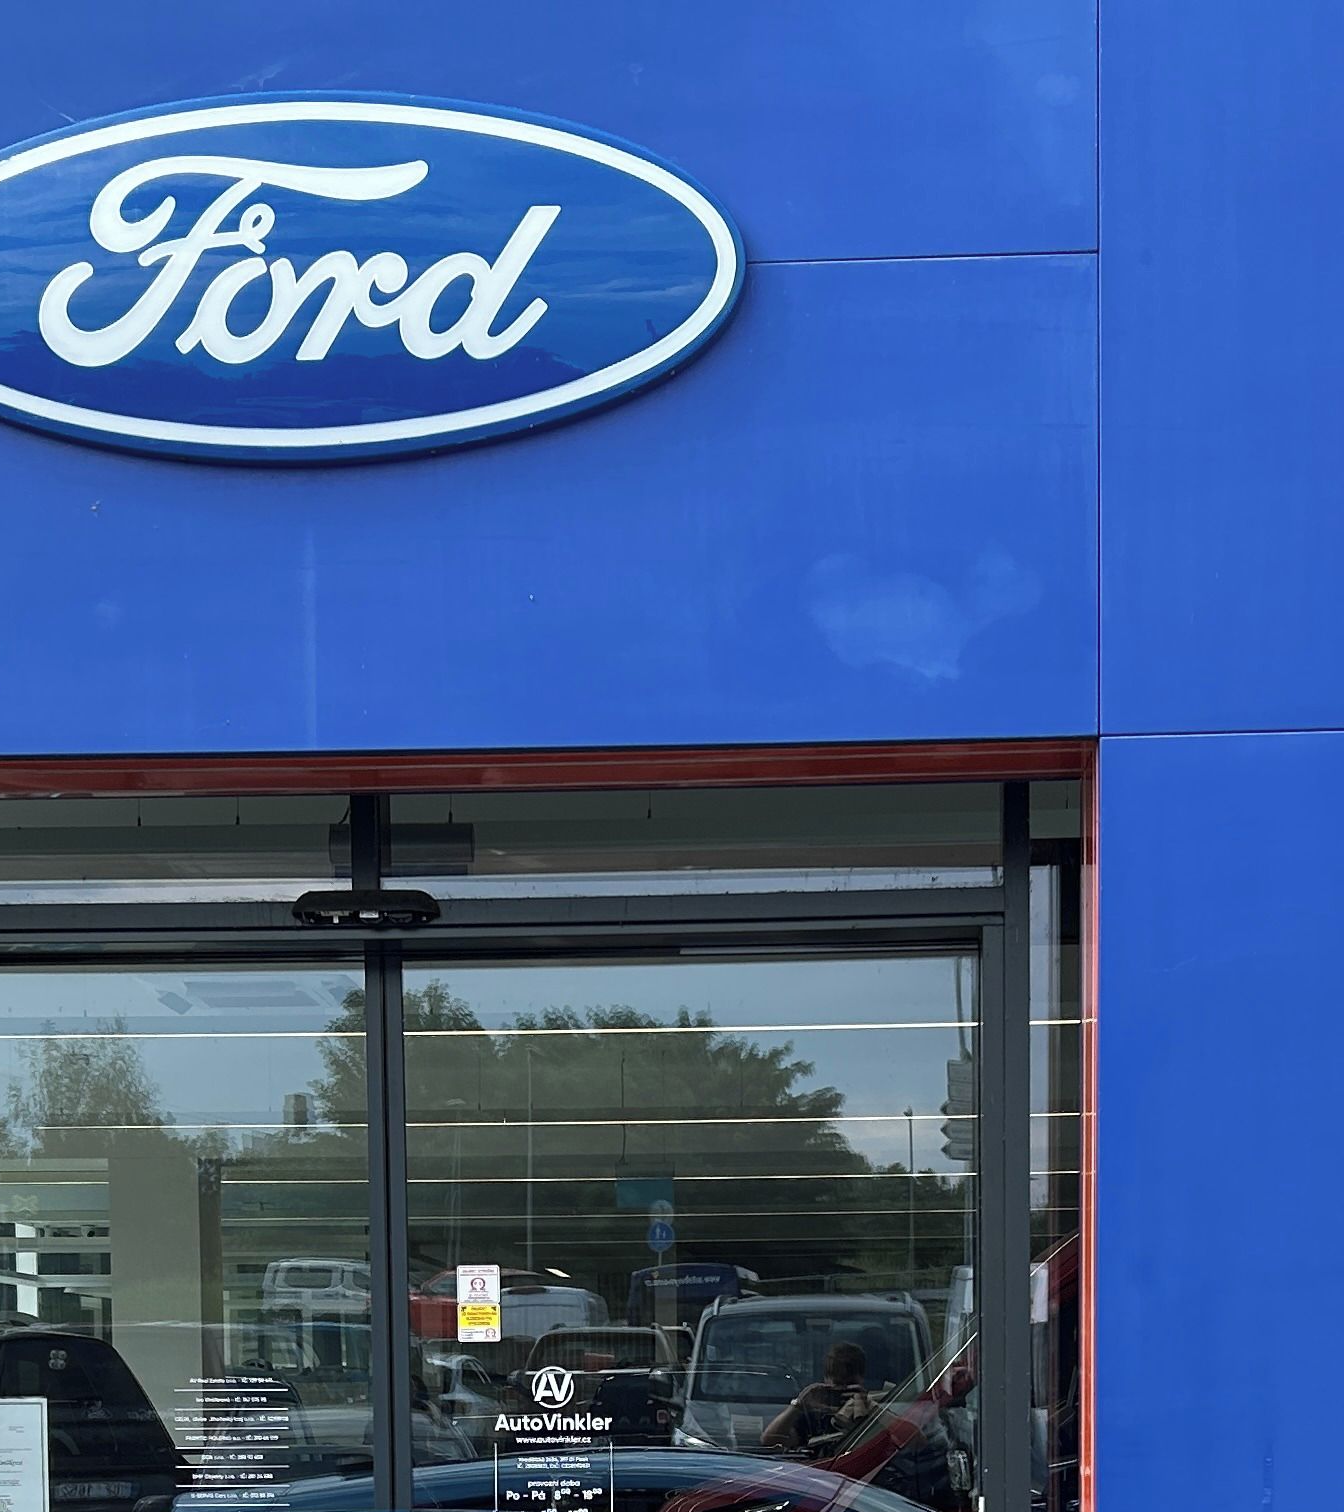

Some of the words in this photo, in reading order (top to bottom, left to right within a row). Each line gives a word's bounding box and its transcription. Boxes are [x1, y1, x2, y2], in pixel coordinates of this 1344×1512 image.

[39, 155, 562, 367] Ford
[534, 1373, 573, 1402] AV
[494, 1413, 613, 1431] AutoVinkler
[515, 1435, 592, 1445] www.autovinkler.cz
[505, 1490, 520, 1500] Po
[531, 1489, 546, 1500] Pá
